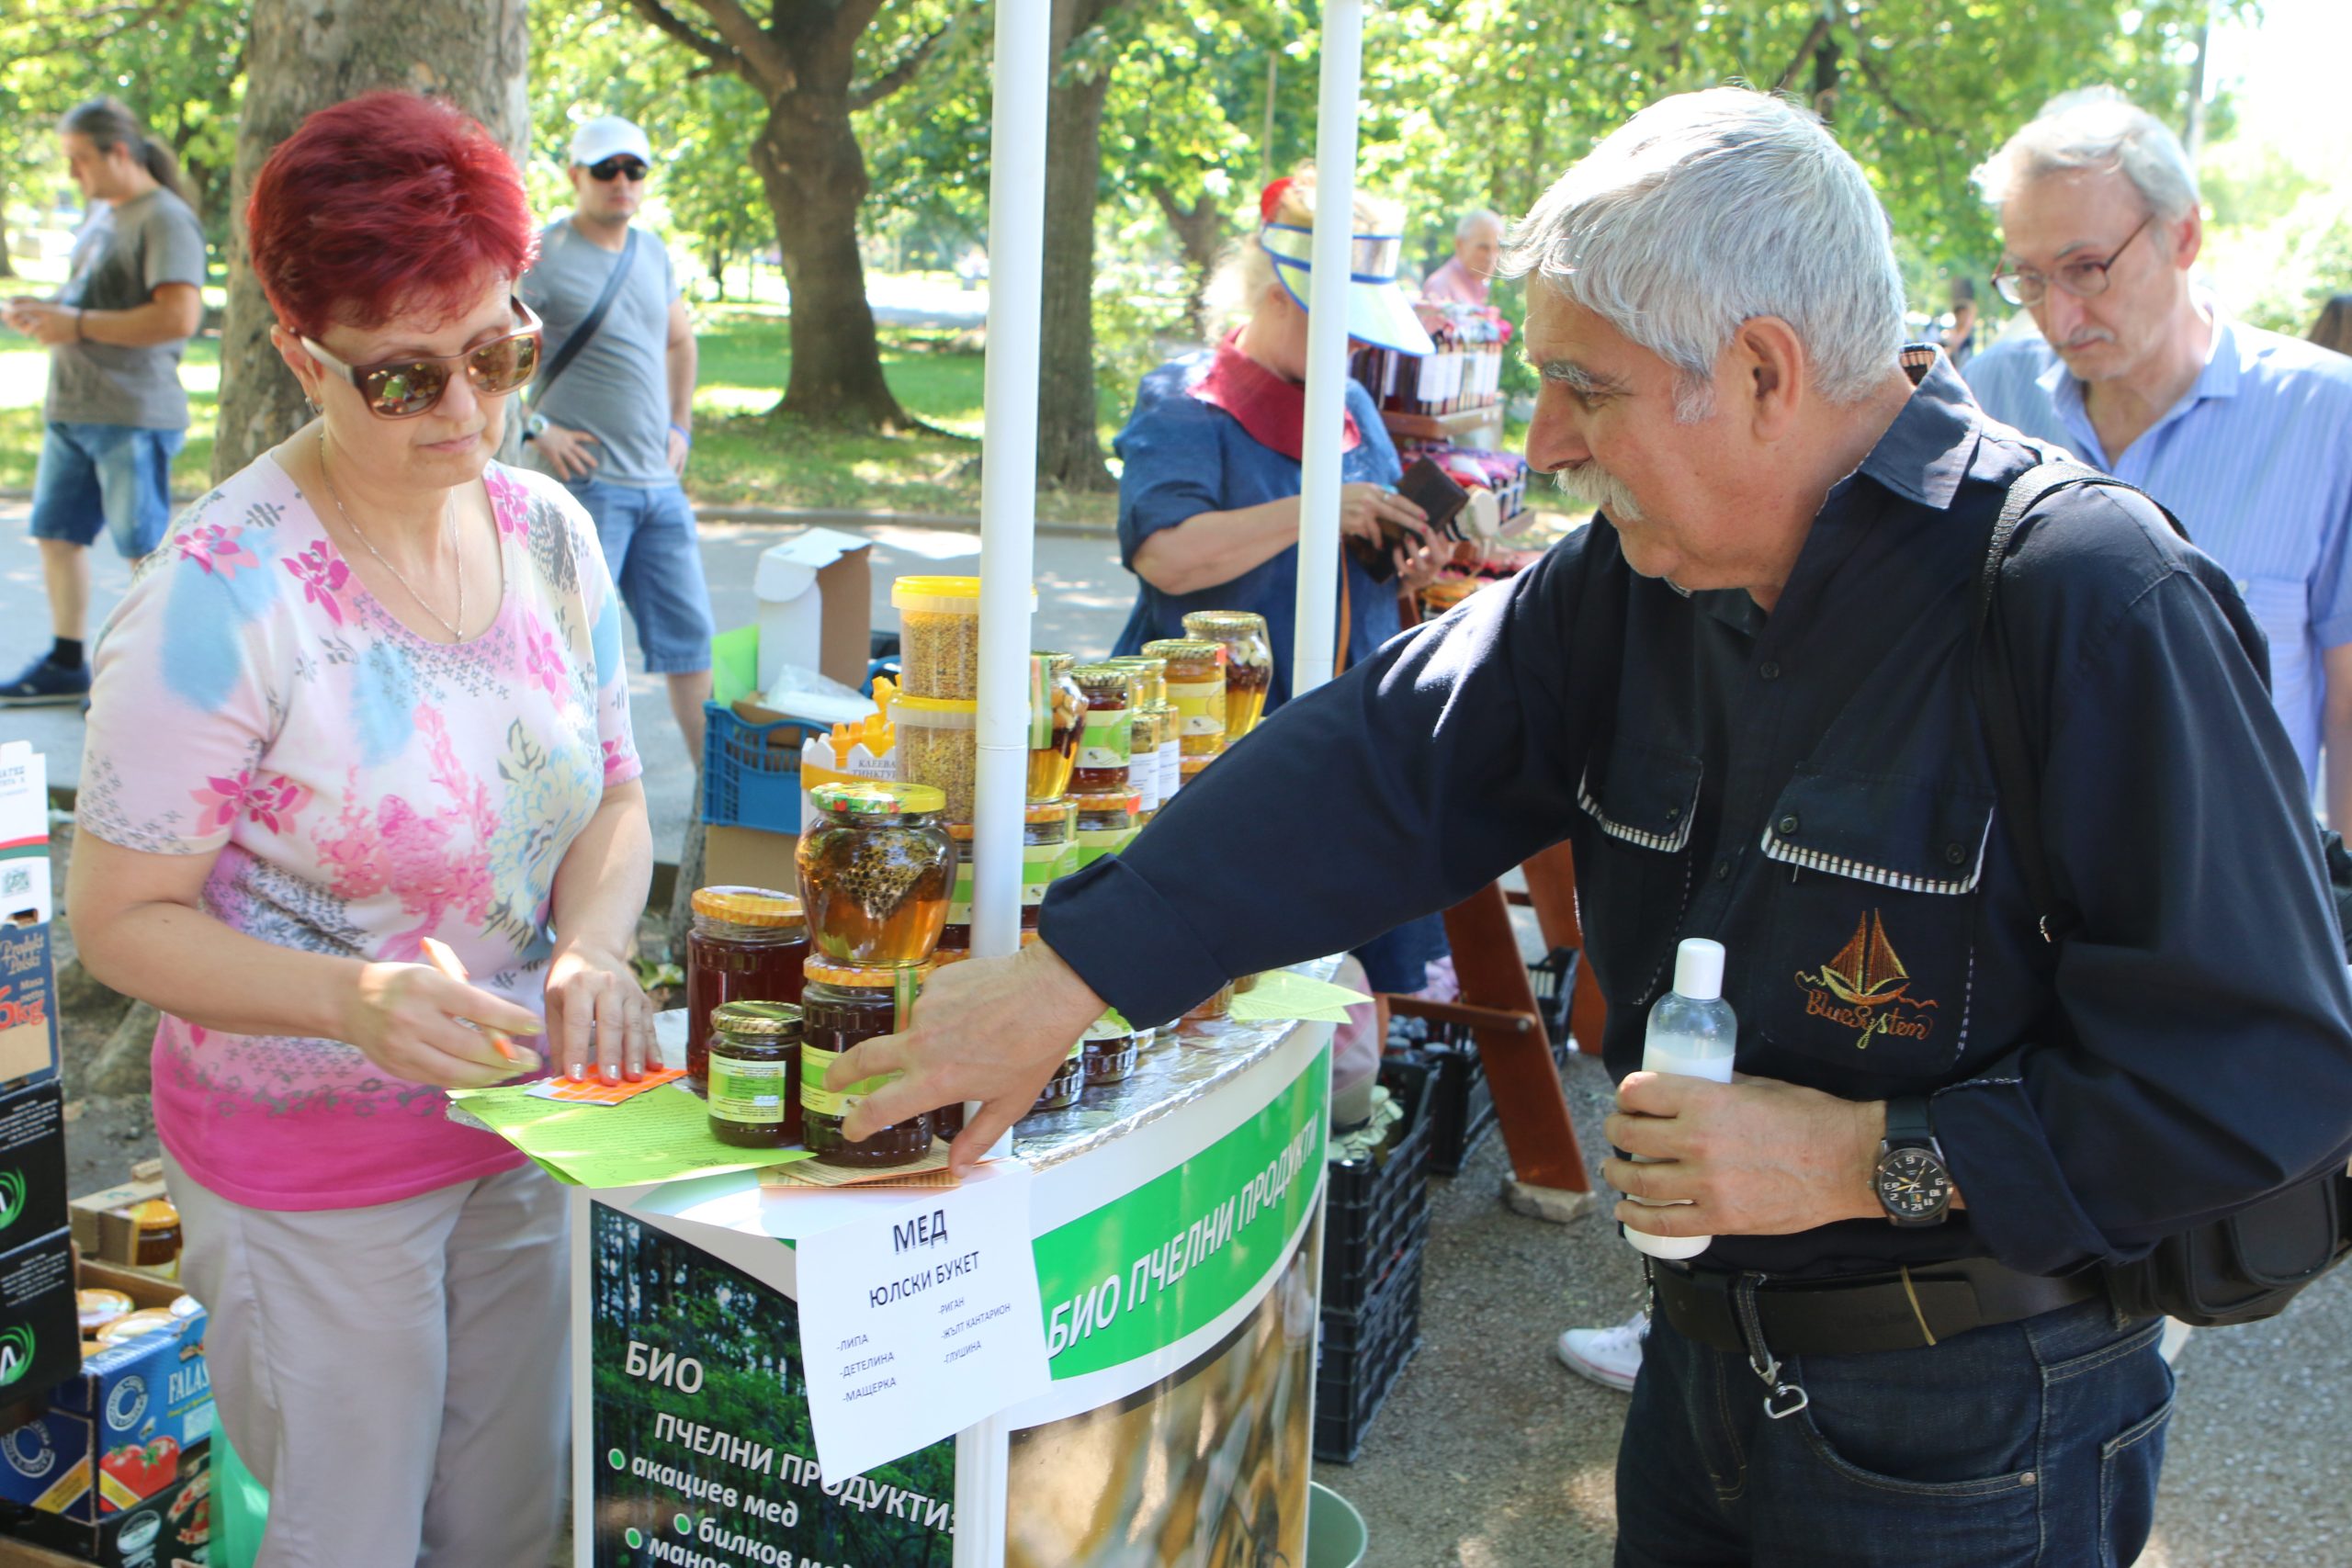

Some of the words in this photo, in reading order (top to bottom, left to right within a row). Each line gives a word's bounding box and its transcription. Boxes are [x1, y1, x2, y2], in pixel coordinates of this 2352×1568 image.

[893, 1209, 948, 1255] МЕД
[1046, 1274, 1121, 1359] БИО
[1127, 1195, 1236, 1312] ПЧЕЛНИ
[1237, 1108, 1318, 1233] ПРОДУКТИ
[869, 1269, 933, 1308] ЮЛСКИ
[935, 1251, 979, 1285] БУКЕТ
[966, 1303, 1011, 1329] КАНТАРИОН
[836, 1334, 869, 1351] -ЛИПА
[839, 1352, 895, 1379] -ДЕТЕЛИНА
[625, 1340, 704, 1394] БИО
[842, 1377, 897, 1402] -МАЩЕРКА
[654, 1412, 774, 1475] ПЧЕЛНИ
[631, 1456, 738, 1508] акациев
[742, 1495, 798, 1528] мед
[648, 1537, 732, 1568] мано
[698, 1517, 792, 1568] билков
